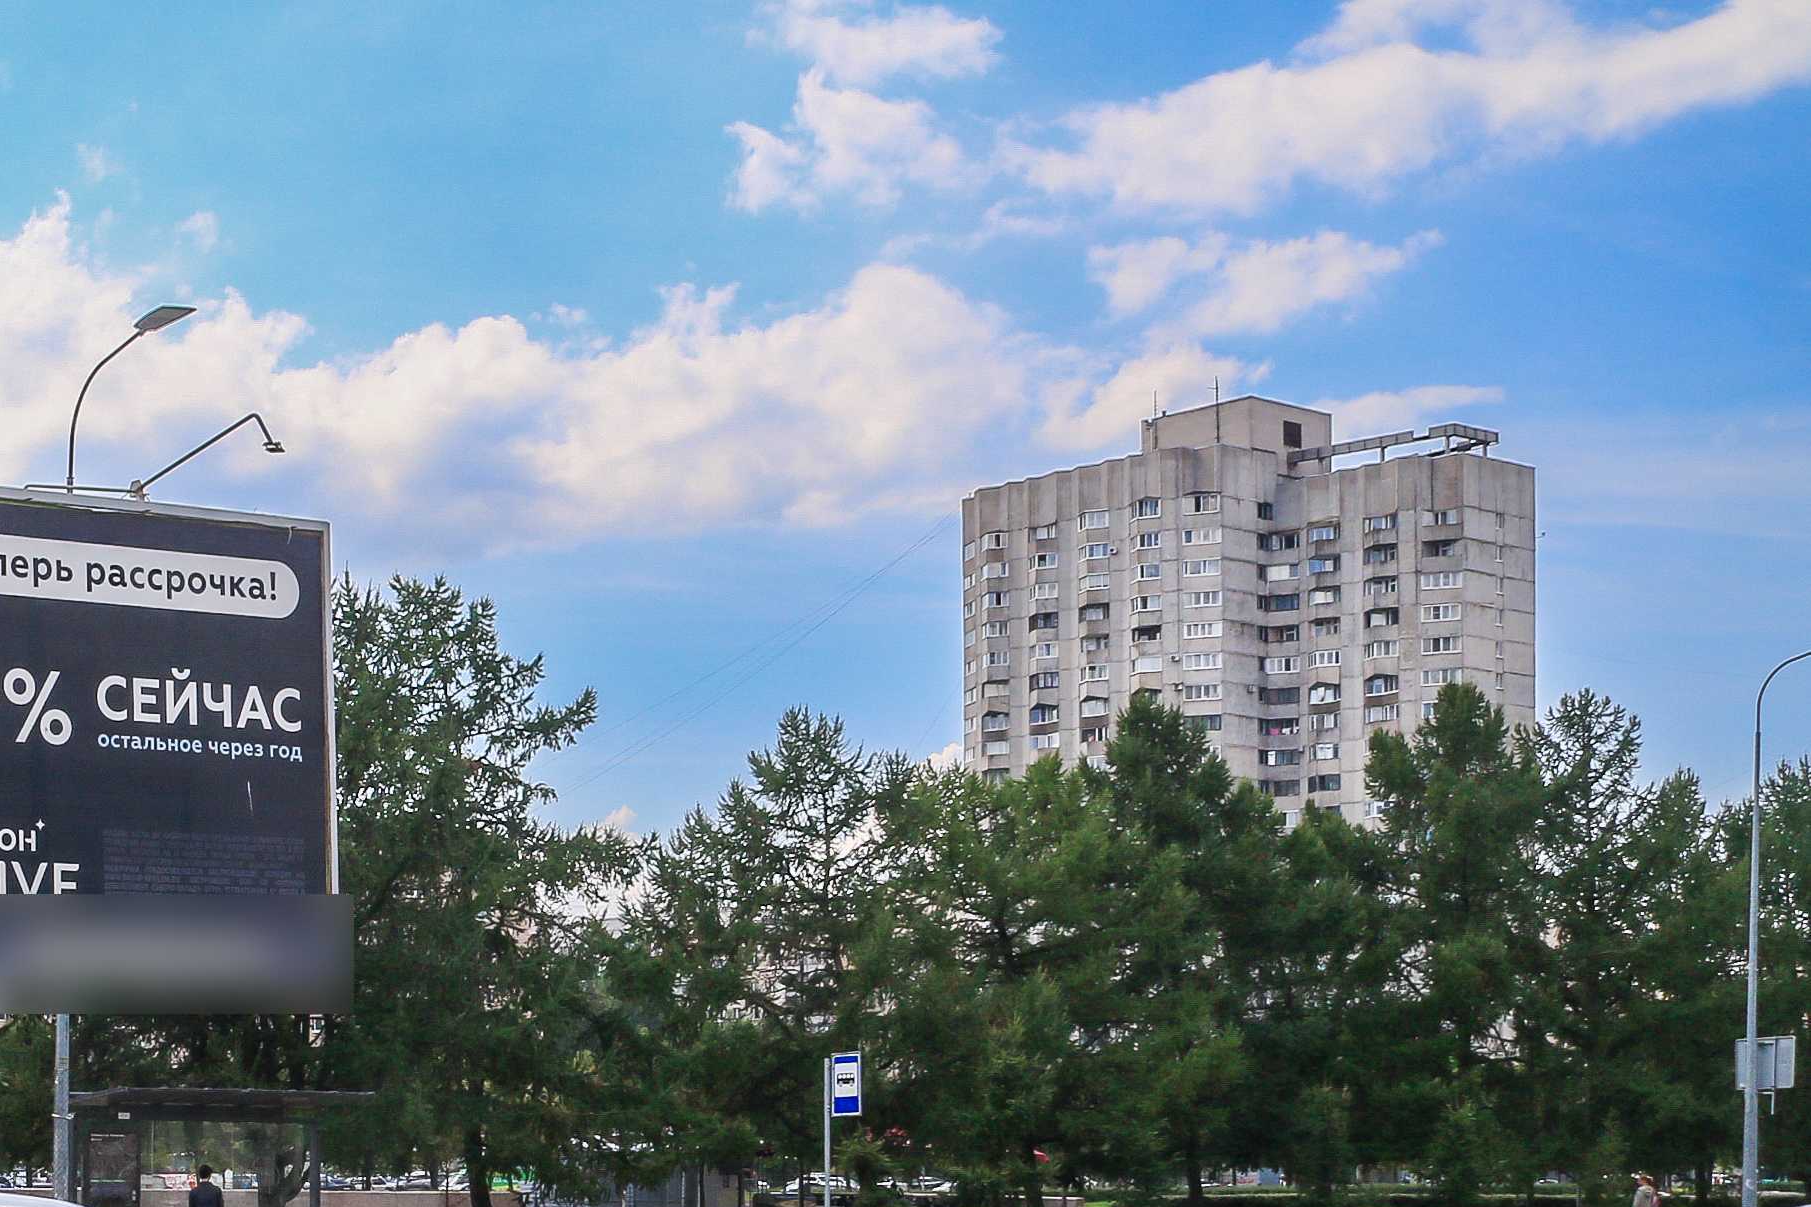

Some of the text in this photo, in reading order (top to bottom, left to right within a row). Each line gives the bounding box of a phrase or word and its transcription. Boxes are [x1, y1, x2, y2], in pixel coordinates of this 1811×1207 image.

[86, 561, 278, 601] рассрочка!
[96, 667, 302, 733] СЕЙЧАС
[97, 731, 303, 763] остальное через год
